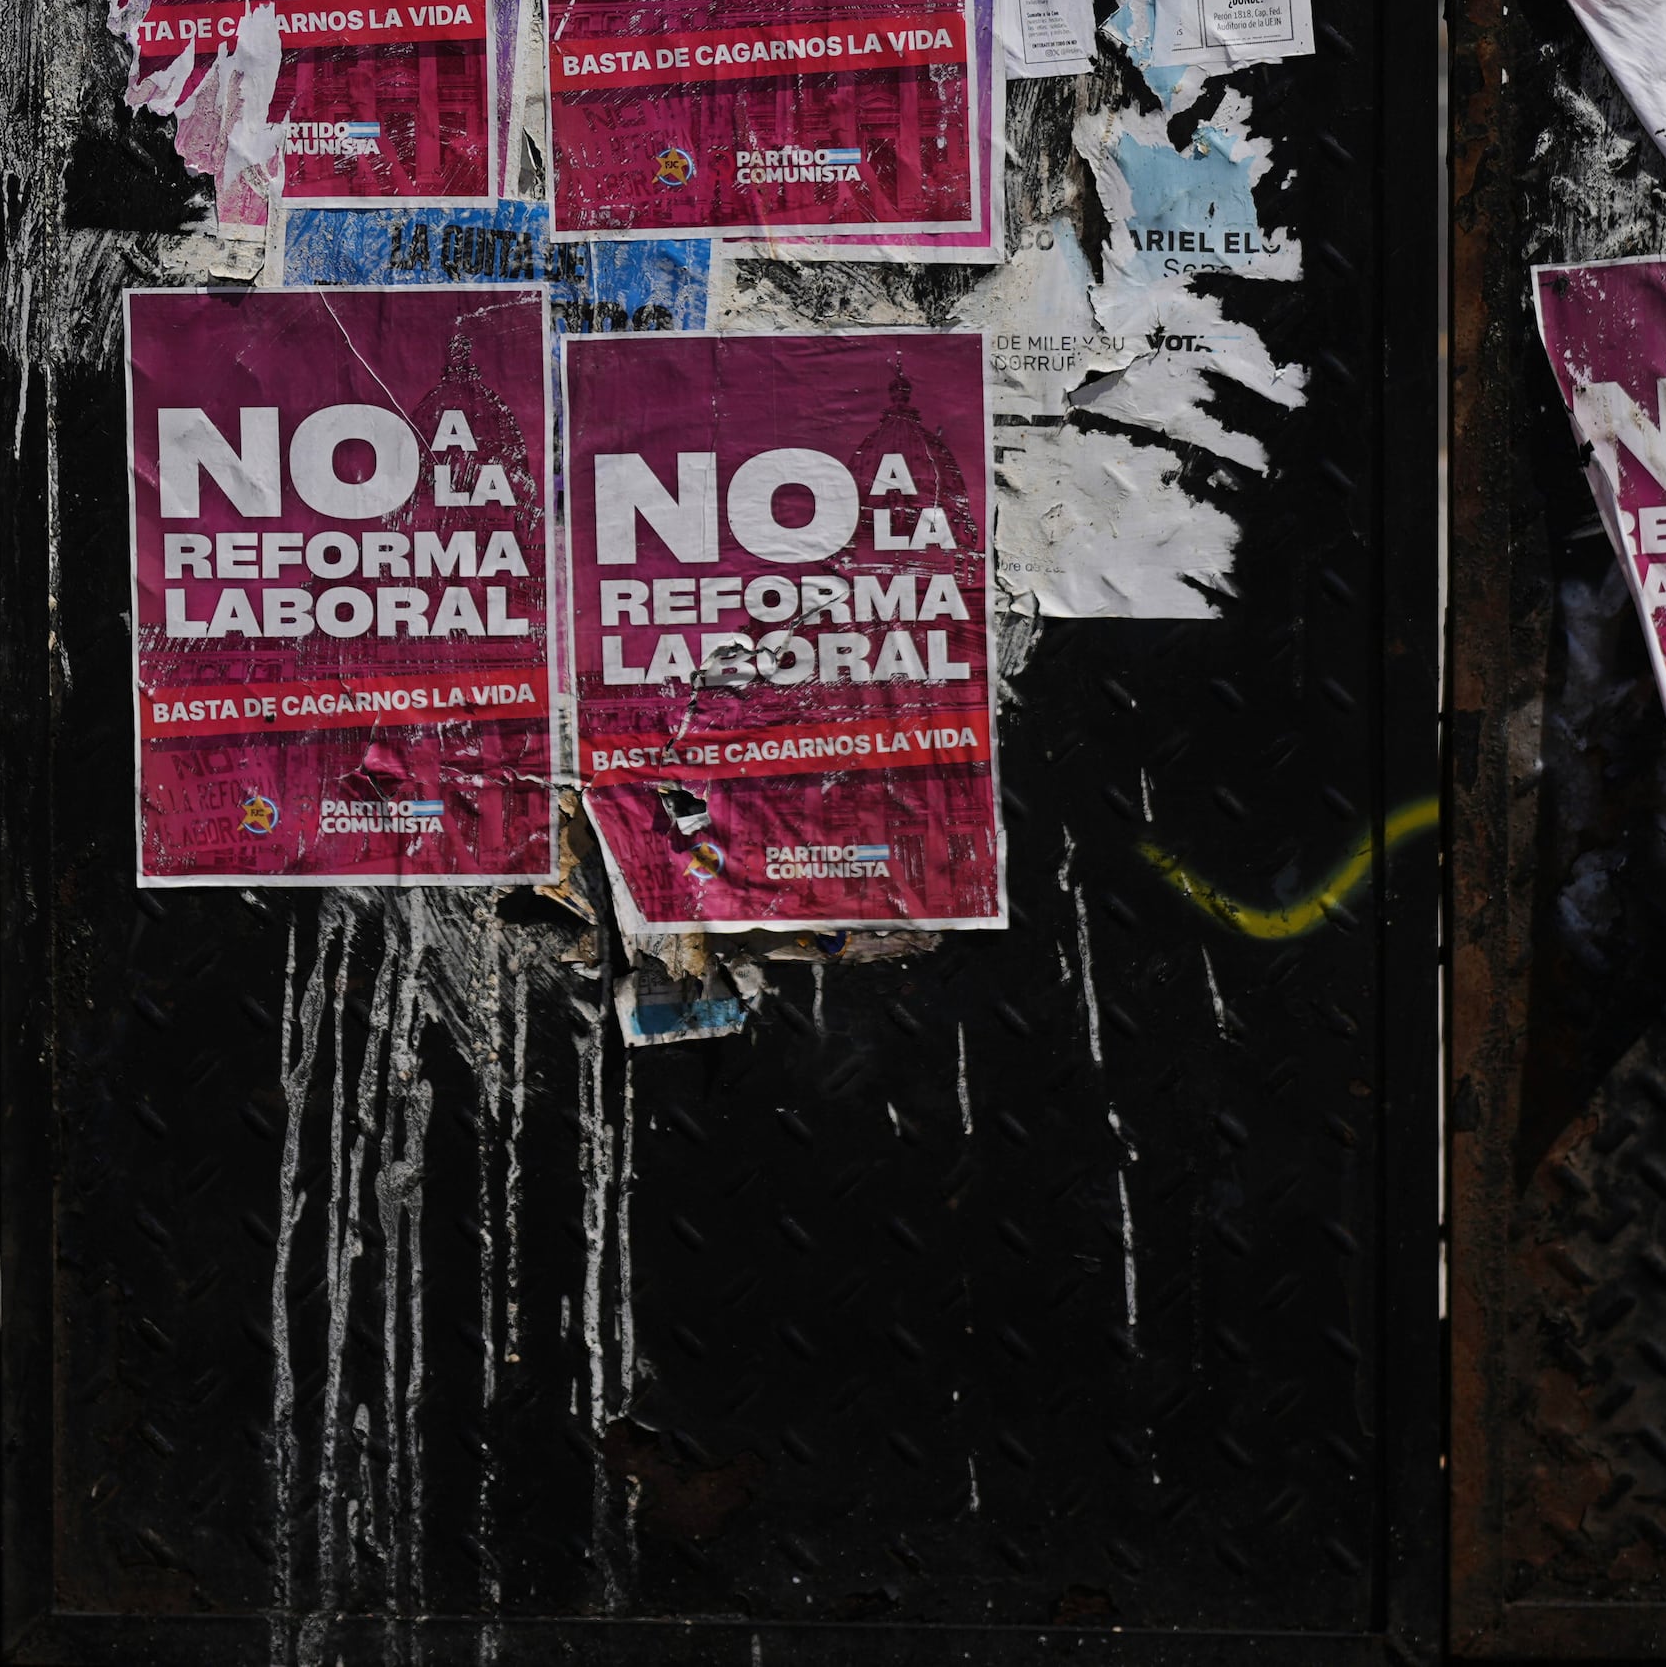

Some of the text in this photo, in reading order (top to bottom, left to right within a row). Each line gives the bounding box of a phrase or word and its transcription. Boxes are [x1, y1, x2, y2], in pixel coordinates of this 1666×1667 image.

[179, 4, 472, 39] DE LA VIDA
[1217, 20, 1247, 31] Auditorio
[1249, 20, 1256, 29] de
[562, 28, 953, 77] BASTA DE CAGARNOS LA VIDA
[737, 149, 829, 167] PARTIDO
[737, 166, 861, 184] COMUNISTA
[998, 335, 1020, 351] DE
[158, 403, 477, 519] NO A
[434, 465, 517, 507] LA
[593, 448, 918, 565] NO A
[873, 507, 956, 552] LA
[164, 531, 529, 579] REFORMA
[165, 587, 529, 637] LABORAL
[600, 575, 970, 626] REFORMA
[602, 631, 970, 686] LABORAL
[153, 683, 535, 723] BASTA DE CAGARNOS LA VIDA
[592, 727, 977, 772] BASTA DE CAGARNOS LA VIDA
[322, 800, 412, 817] PARTIDO
[322, 817, 444, 834] COMUNISTA
[766, 846, 858, 862] PARTIDO
[766, 862, 889, 879] COMUNISTA
